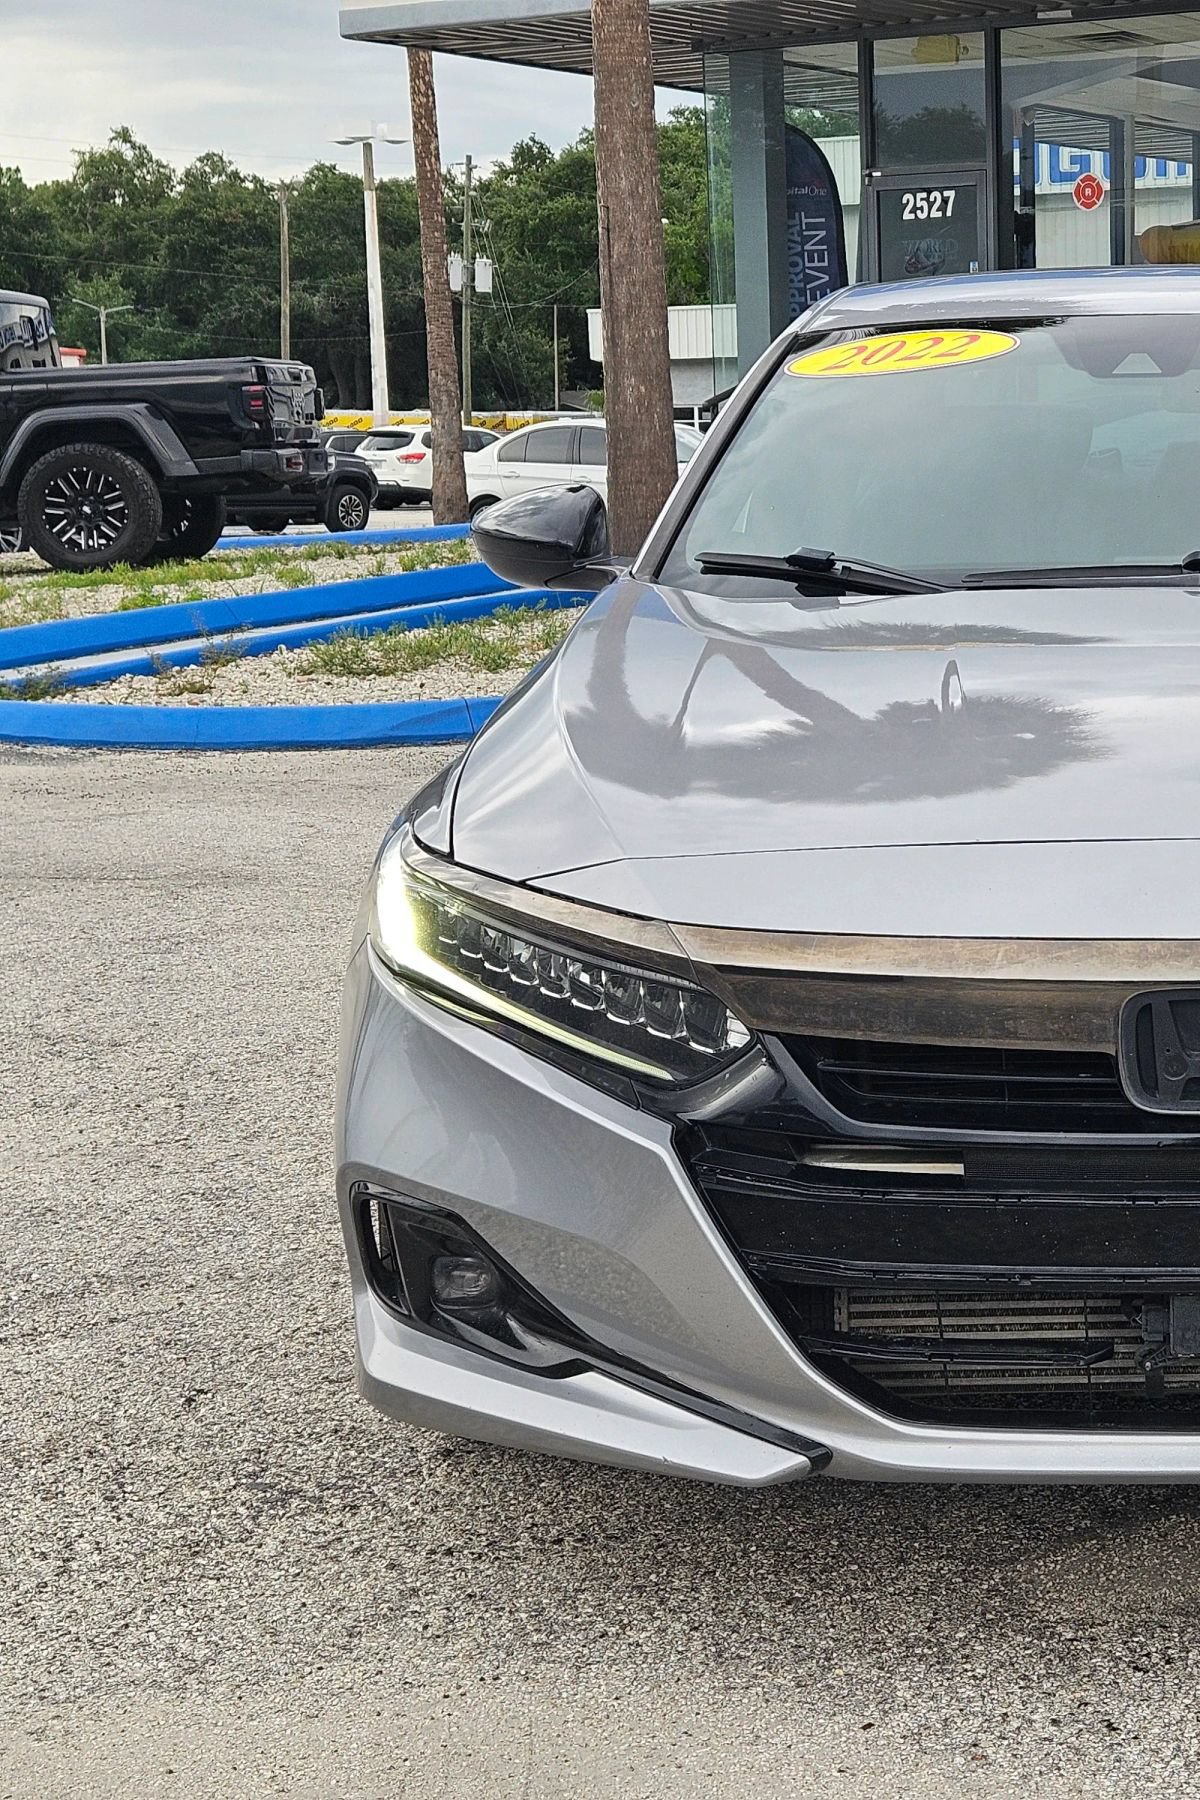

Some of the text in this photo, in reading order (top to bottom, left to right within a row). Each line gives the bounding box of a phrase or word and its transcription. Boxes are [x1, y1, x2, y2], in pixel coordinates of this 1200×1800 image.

[902, 190, 956, 220] 2527
[1084, 187, 1092, 198] R
[787, 211, 805, 318] PPROVAL
[801, 211, 831, 306] EVENT
[817, 334, 982, 372] 2022
